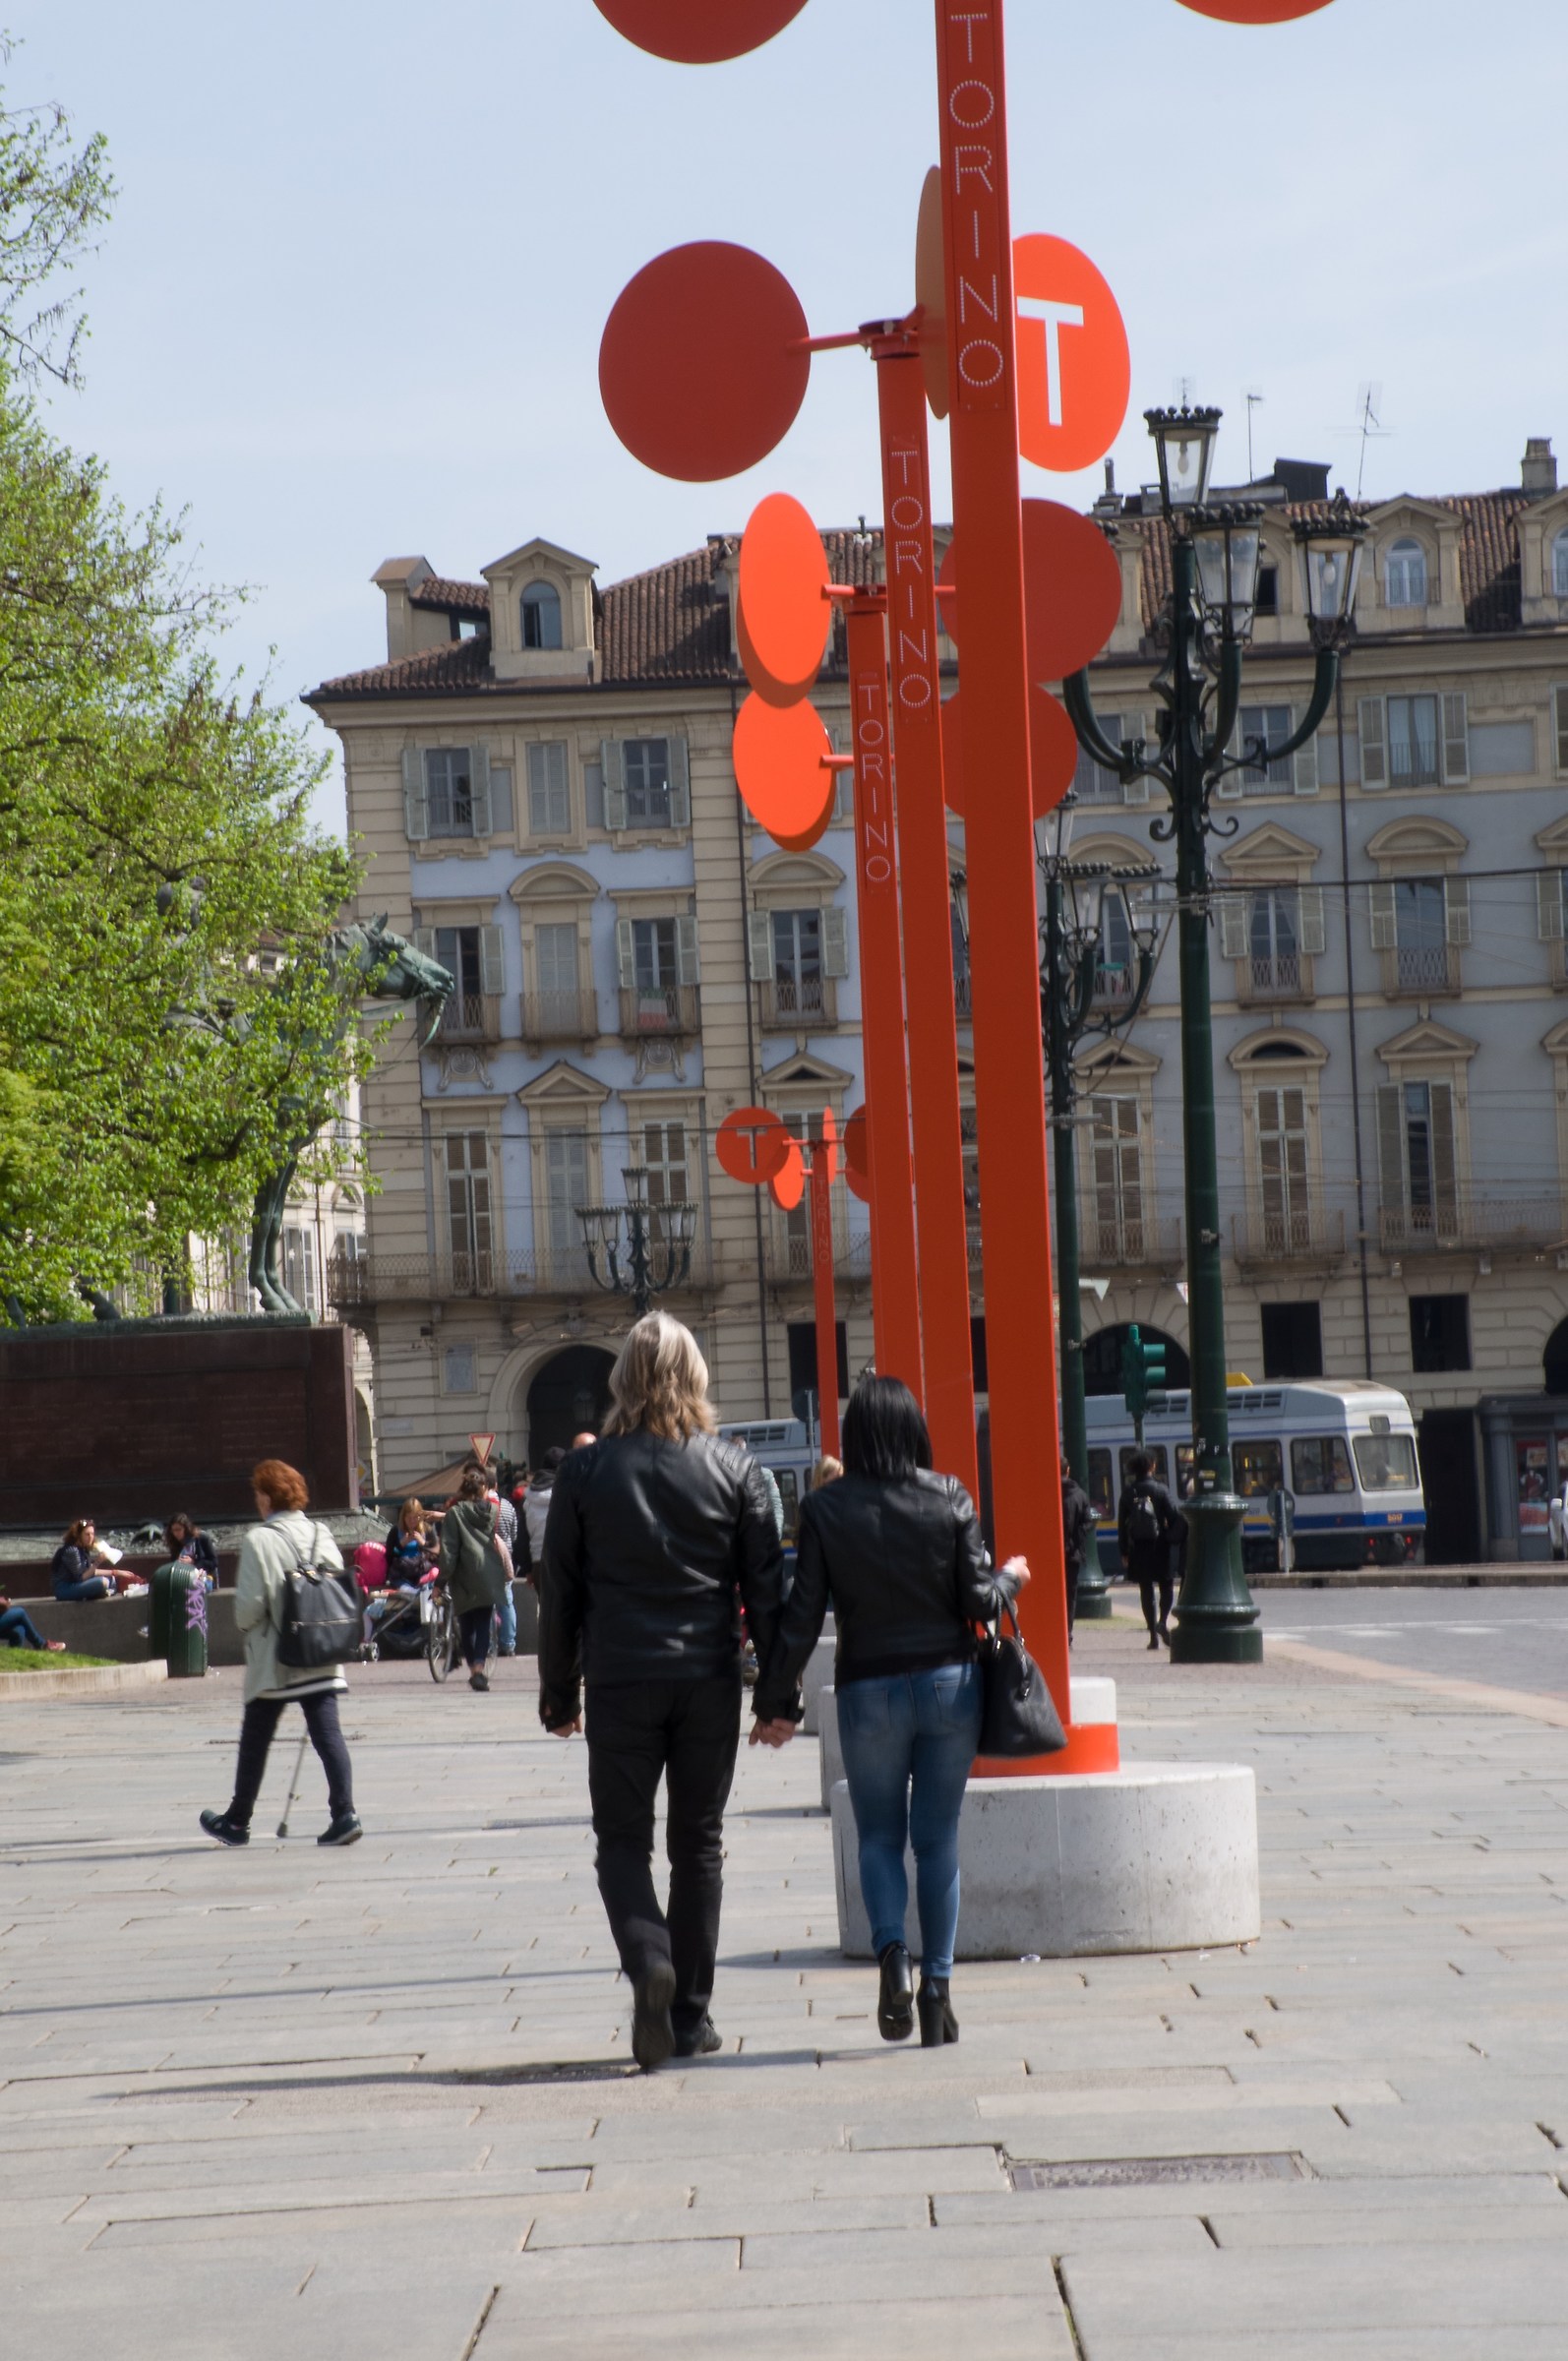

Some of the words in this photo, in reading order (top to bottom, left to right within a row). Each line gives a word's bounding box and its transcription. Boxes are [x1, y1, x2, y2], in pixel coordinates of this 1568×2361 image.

[949, 13, 1003, 387] TORINO
[1016, 296, 1084, 427] T
[891, 450, 932, 708] TORINO
[859, 684, 891, 882] TORINO
[737, 1127, 768, 1170] T
[816, 1180, 830, 1262] TORINO
